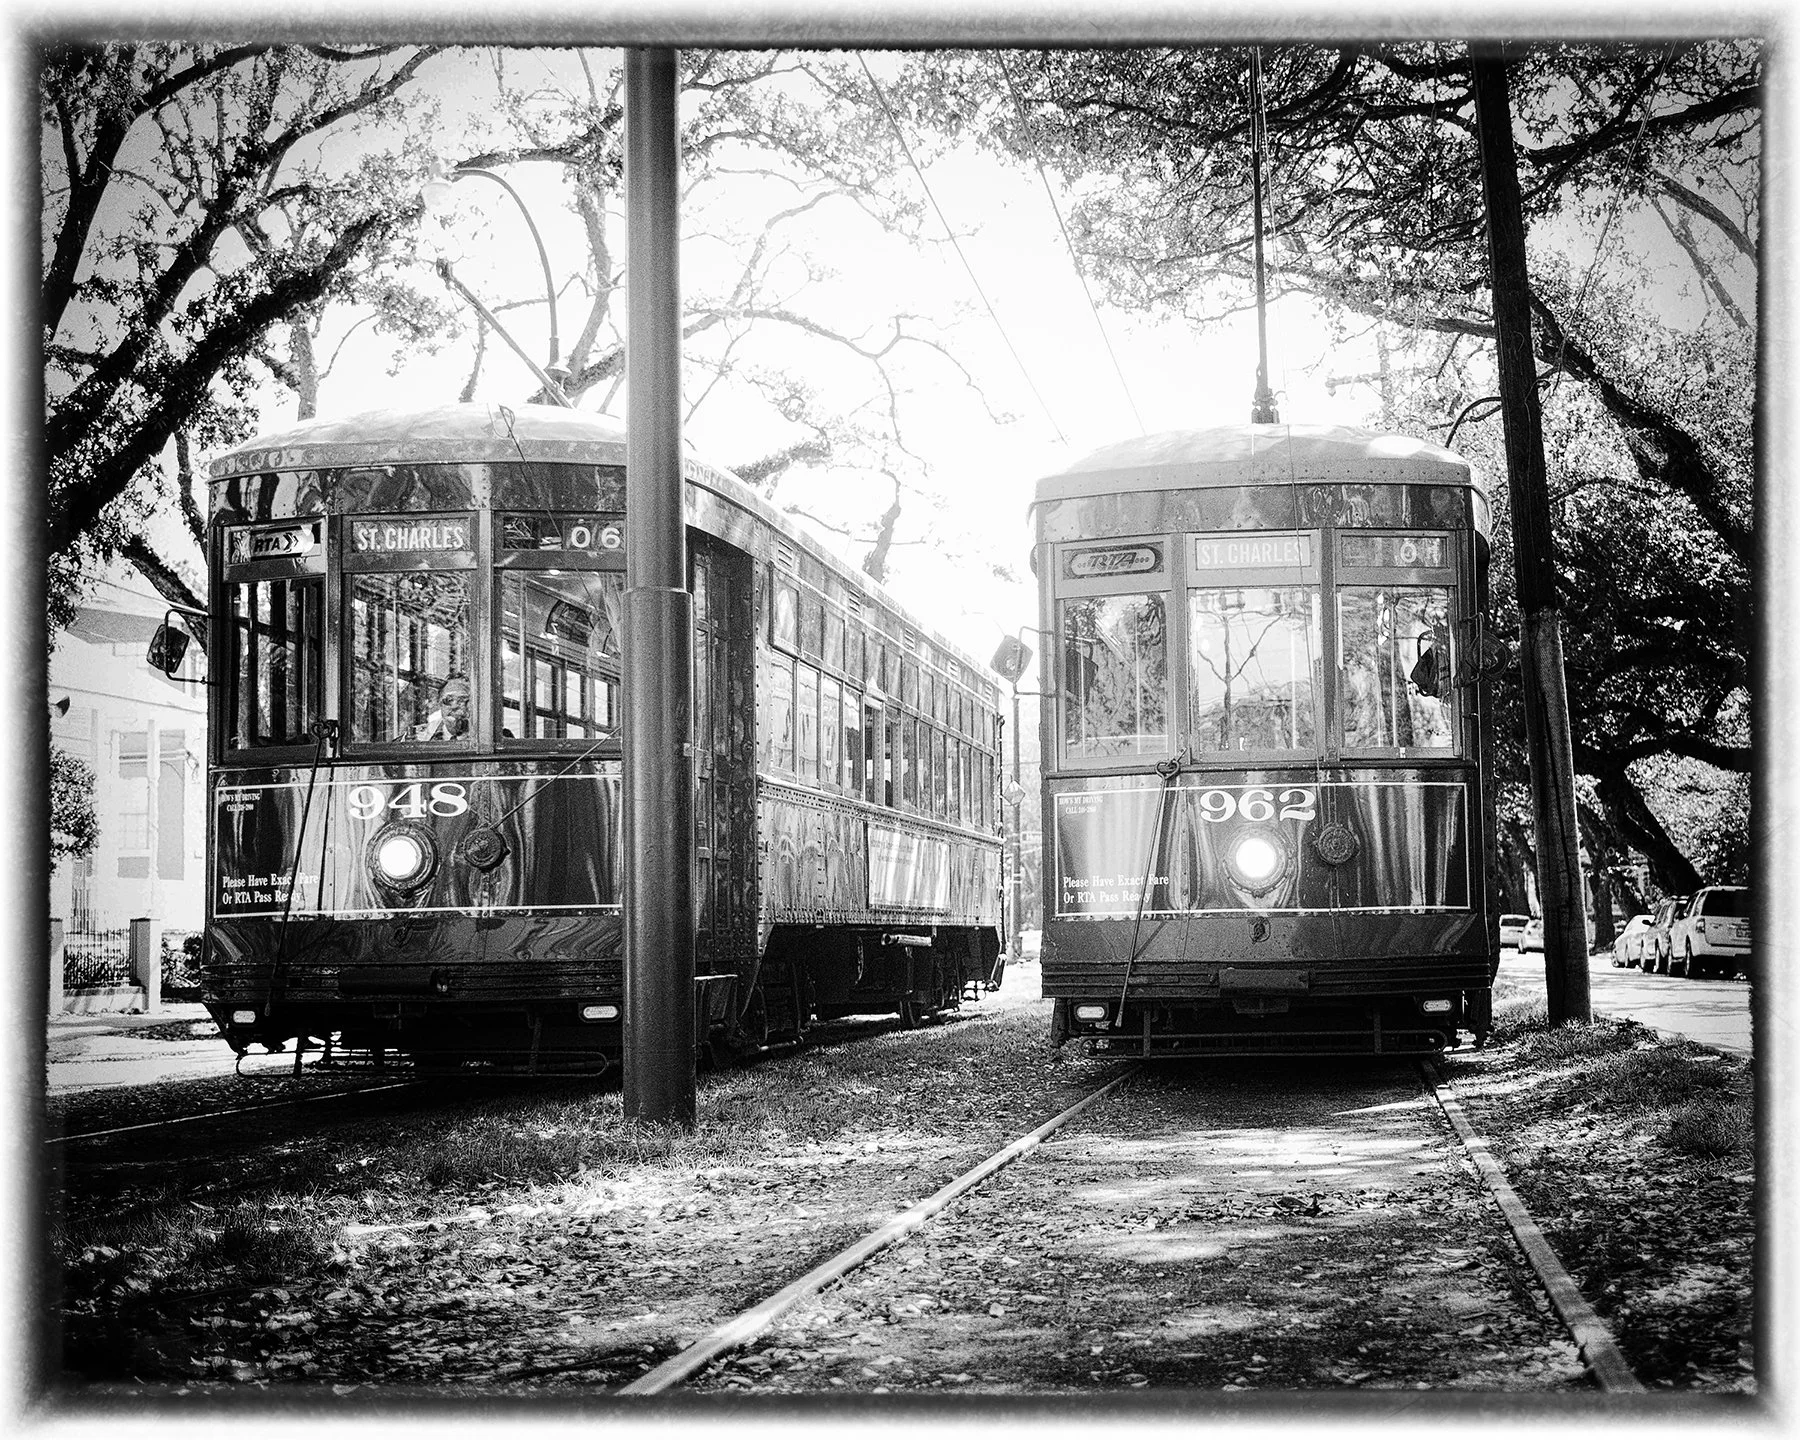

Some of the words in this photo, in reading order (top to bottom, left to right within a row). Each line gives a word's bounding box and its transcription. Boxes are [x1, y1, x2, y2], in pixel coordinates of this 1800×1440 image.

[253, 537, 280, 552] RTA
[357, 528, 381, 550] ST.
[385, 526, 464, 549] CHARLES
[1201, 544, 1224, 565] ST.
[1228, 542, 1303, 564] CHARLES
[348, 783, 468, 820] 948
[1200, 789, 1316, 822] 962
[222, 876, 245, 888] Please
[248, 874, 268, 886] Have
[271, 873, 293, 886] Exac
[299, 872, 318, 884] Fare
[1063, 876, 1089, 888] Please
[1092, 875, 1114, 887] Have
[1117, 874, 1144, 886] Exact
[1148, 873, 1169, 885] Fare
[222, 892, 232, 904] Or
[235, 892, 251, 904] RTA
[254, 891, 272, 903] Pass
[275, 890, 302, 903] Redy
[1063, 892, 1074, 903] Or
[1077, 891, 1096, 903] RTA
[1099, 890, 1119, 902] Pass
[1122, 890, 1151, 903] Reay
